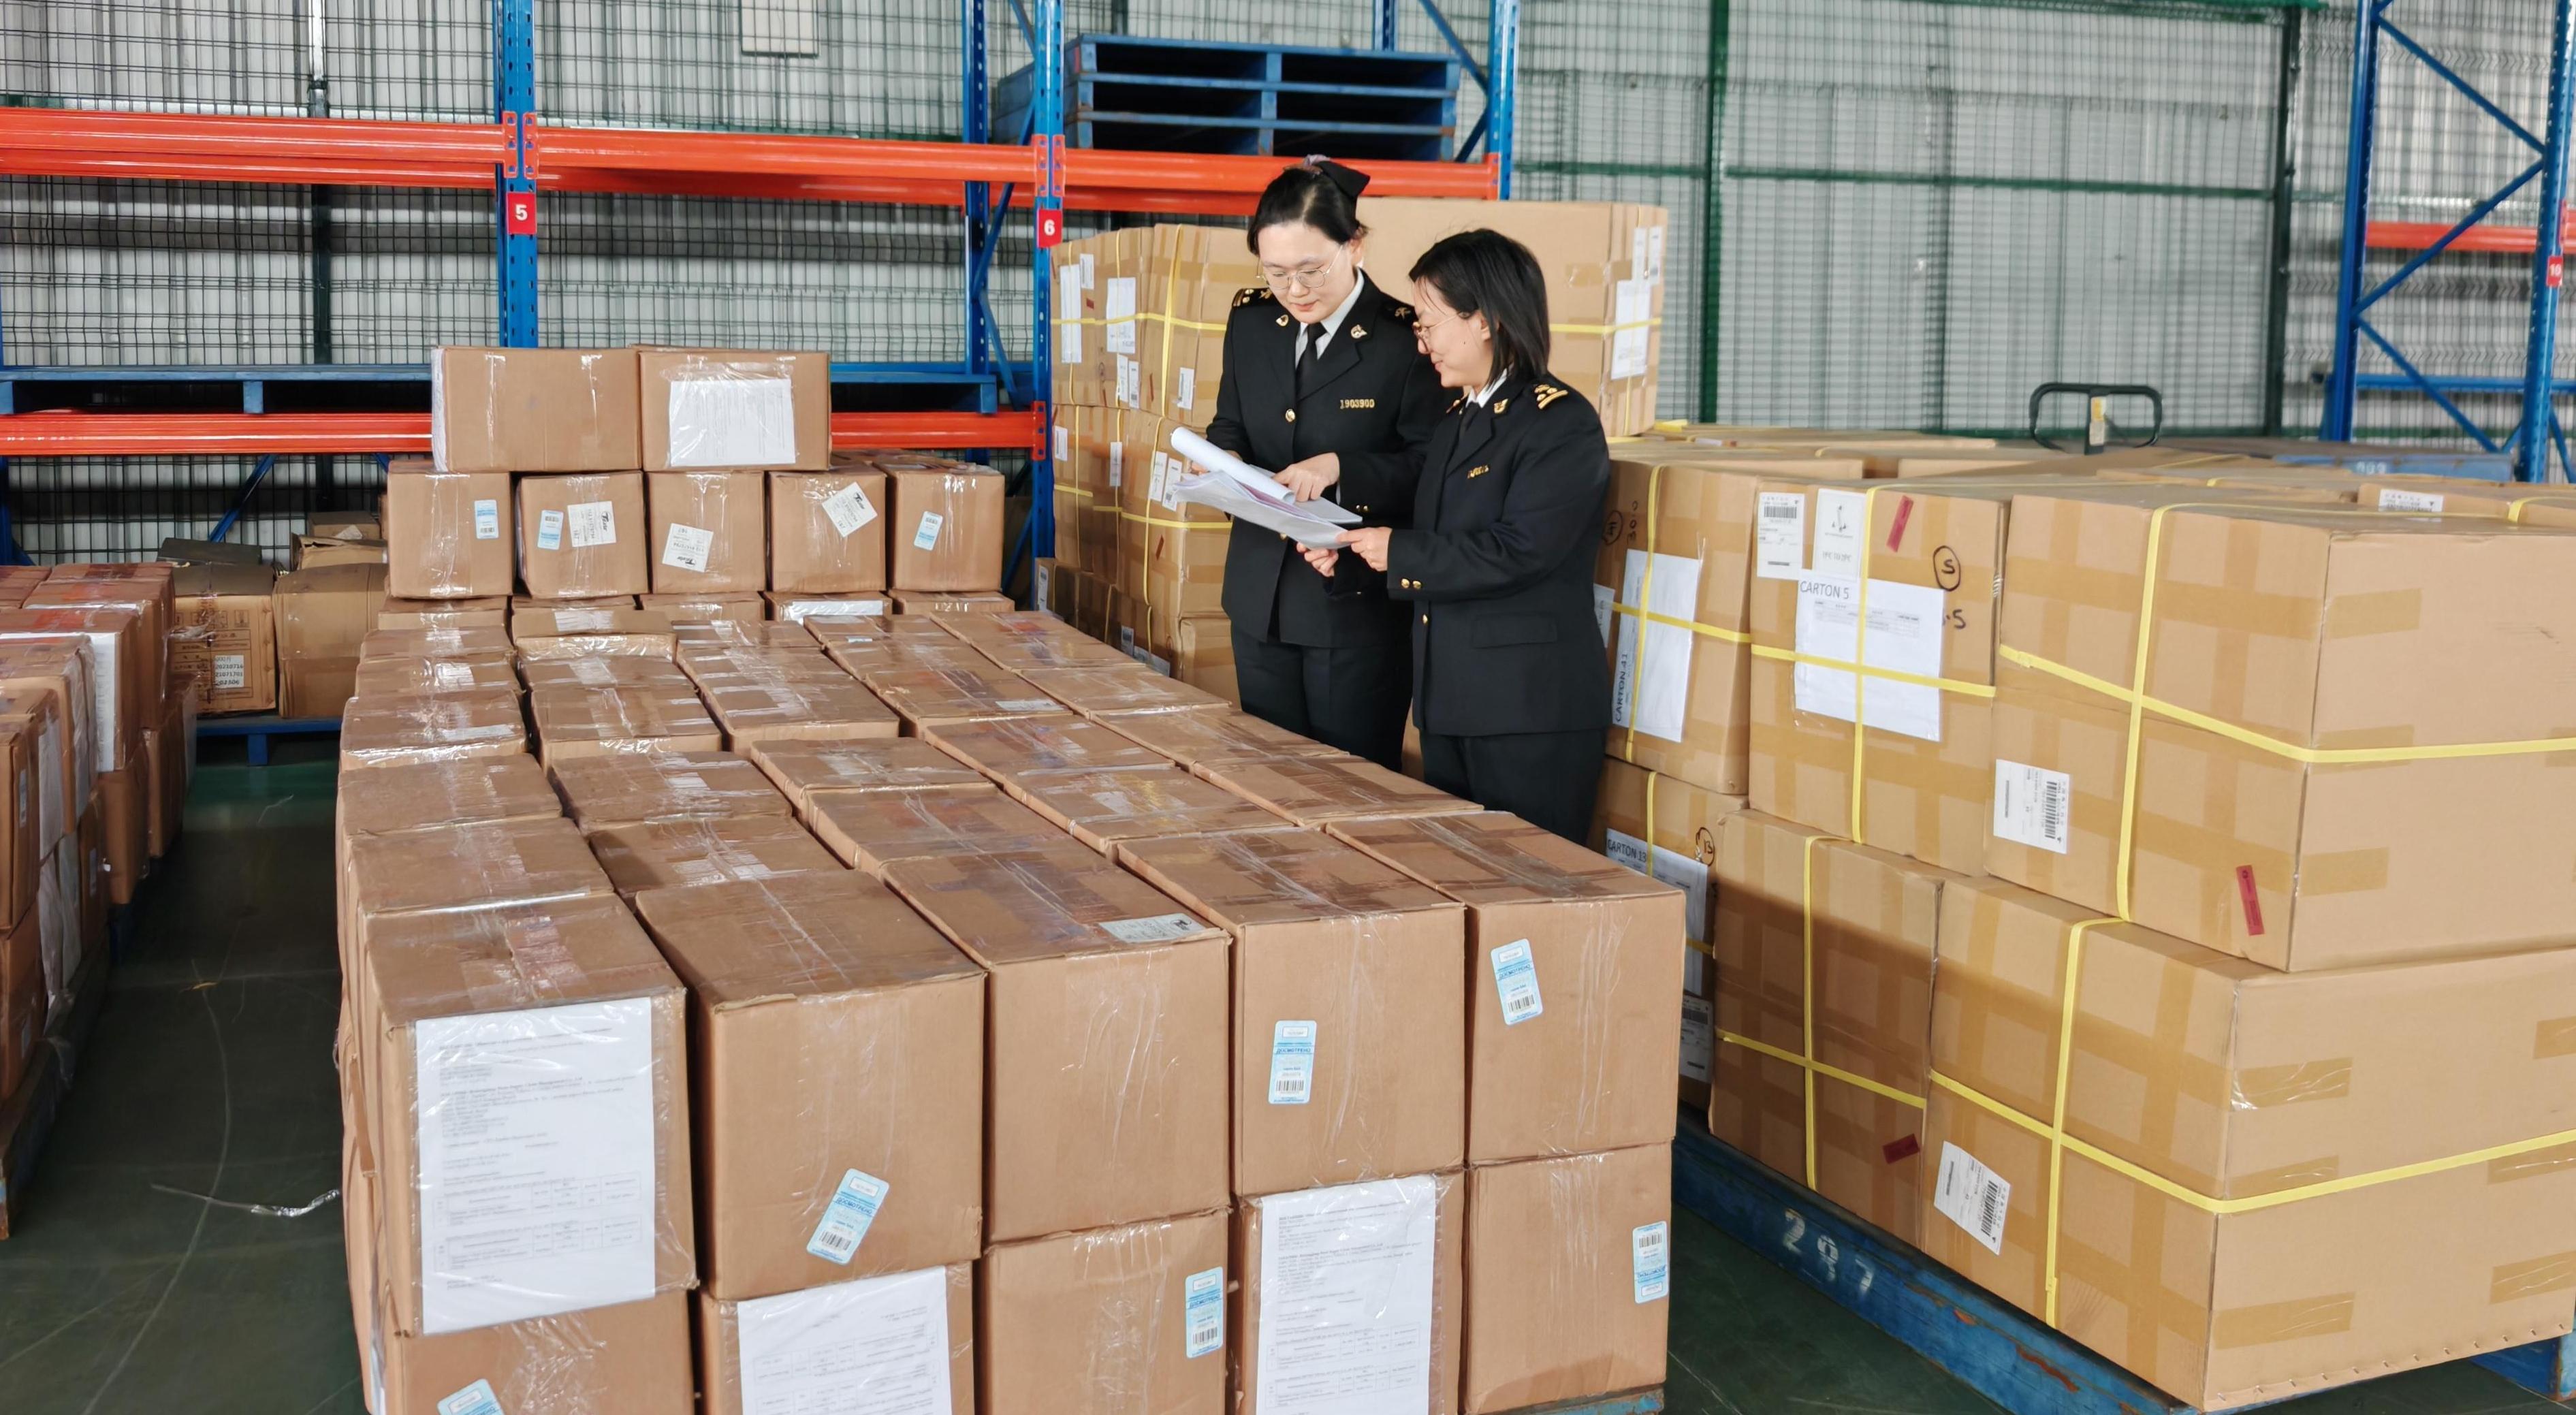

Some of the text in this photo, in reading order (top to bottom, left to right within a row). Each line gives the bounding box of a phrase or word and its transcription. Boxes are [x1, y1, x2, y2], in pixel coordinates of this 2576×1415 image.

[515, 204, 528, 221] 5
[1043, 219, 1056, 236] 6
[1800, 580, 1849, 600] CARTON 5
[1616, 671, 1627, 722] CARTON
[1607, 839, 1647, 863] CARTON 13
[1703, 838, 1713, 855] 13
[1782, 1207, 1874, 1295] 297
